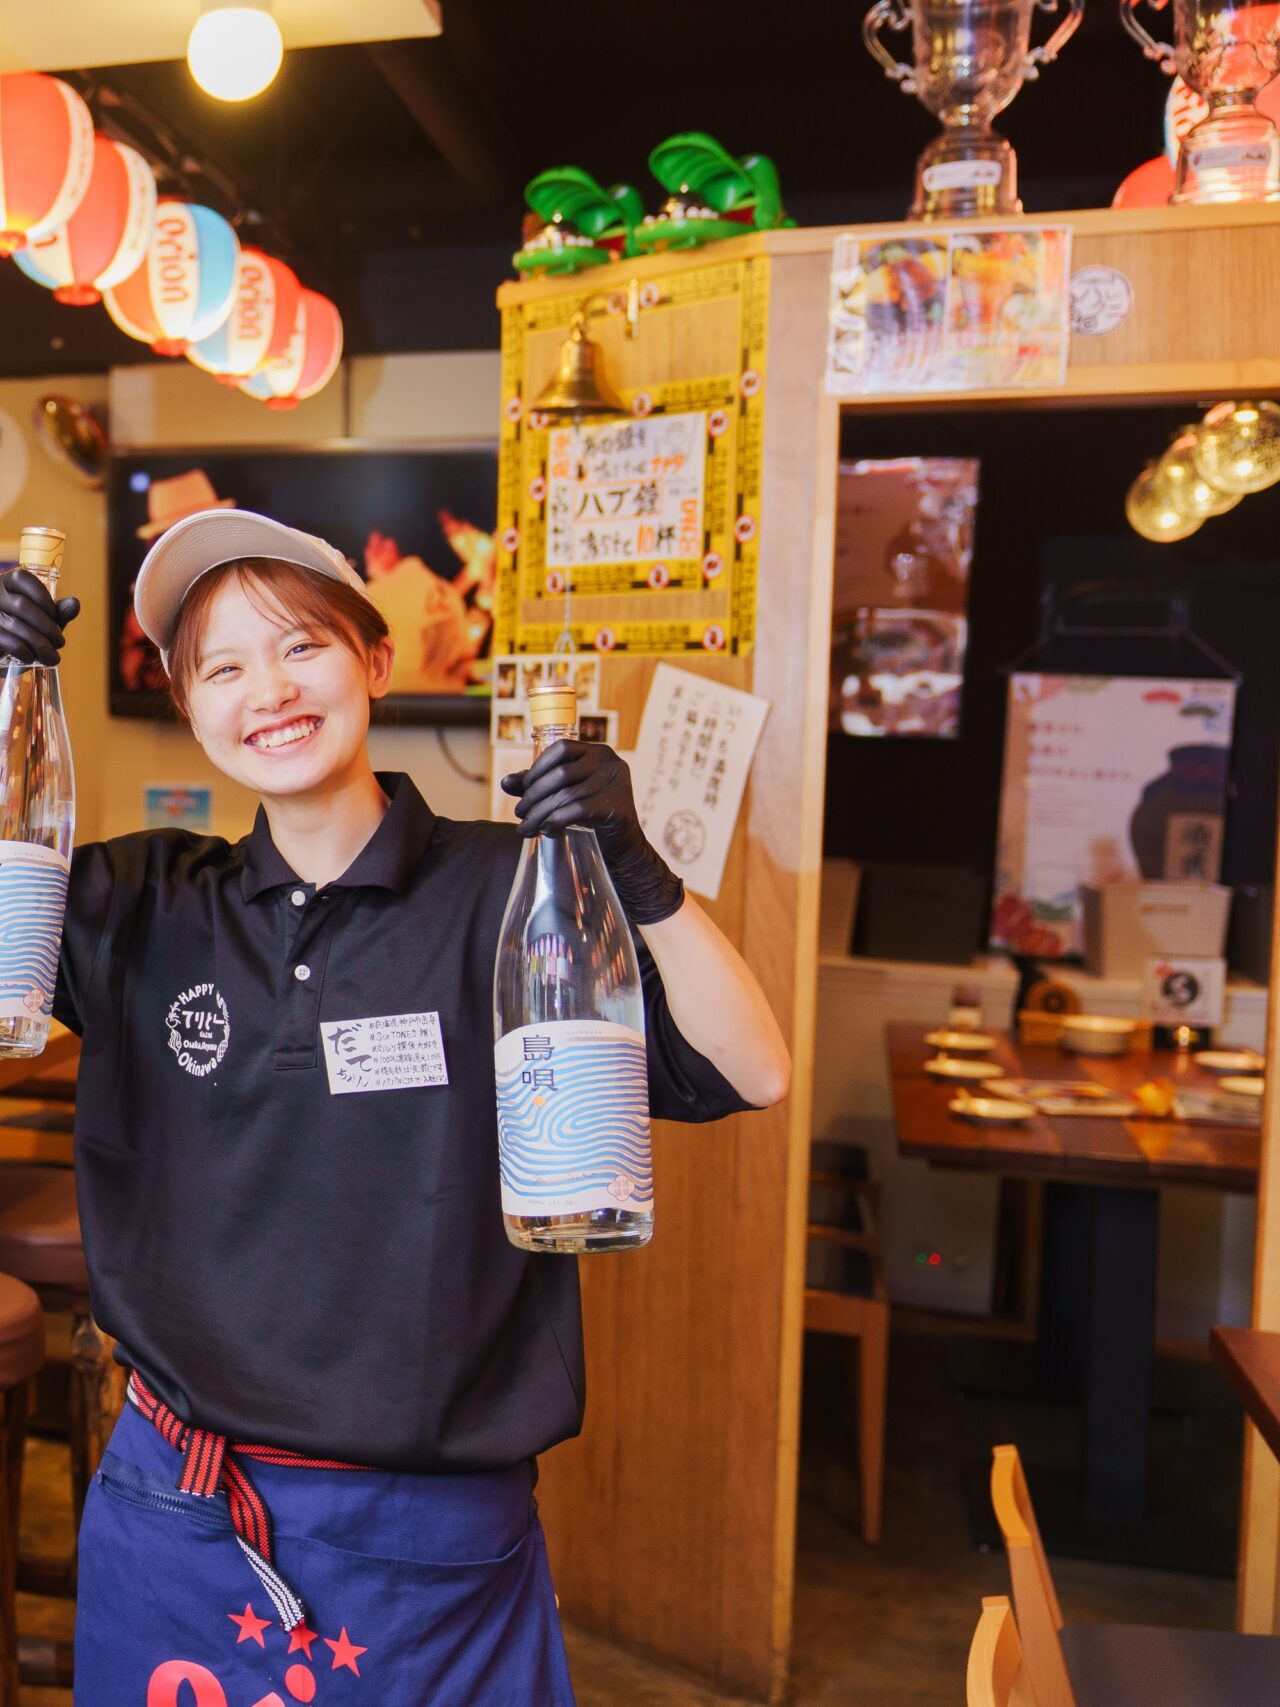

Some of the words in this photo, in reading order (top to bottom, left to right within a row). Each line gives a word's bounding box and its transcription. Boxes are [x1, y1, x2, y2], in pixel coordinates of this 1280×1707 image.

[158, 218, 196, 304] Orion
[177, 983, 215, 1006] HAPPY
[177, 1051, 218, 1078] Okinawa
[522, 1034, 559, 1092] 島唄
